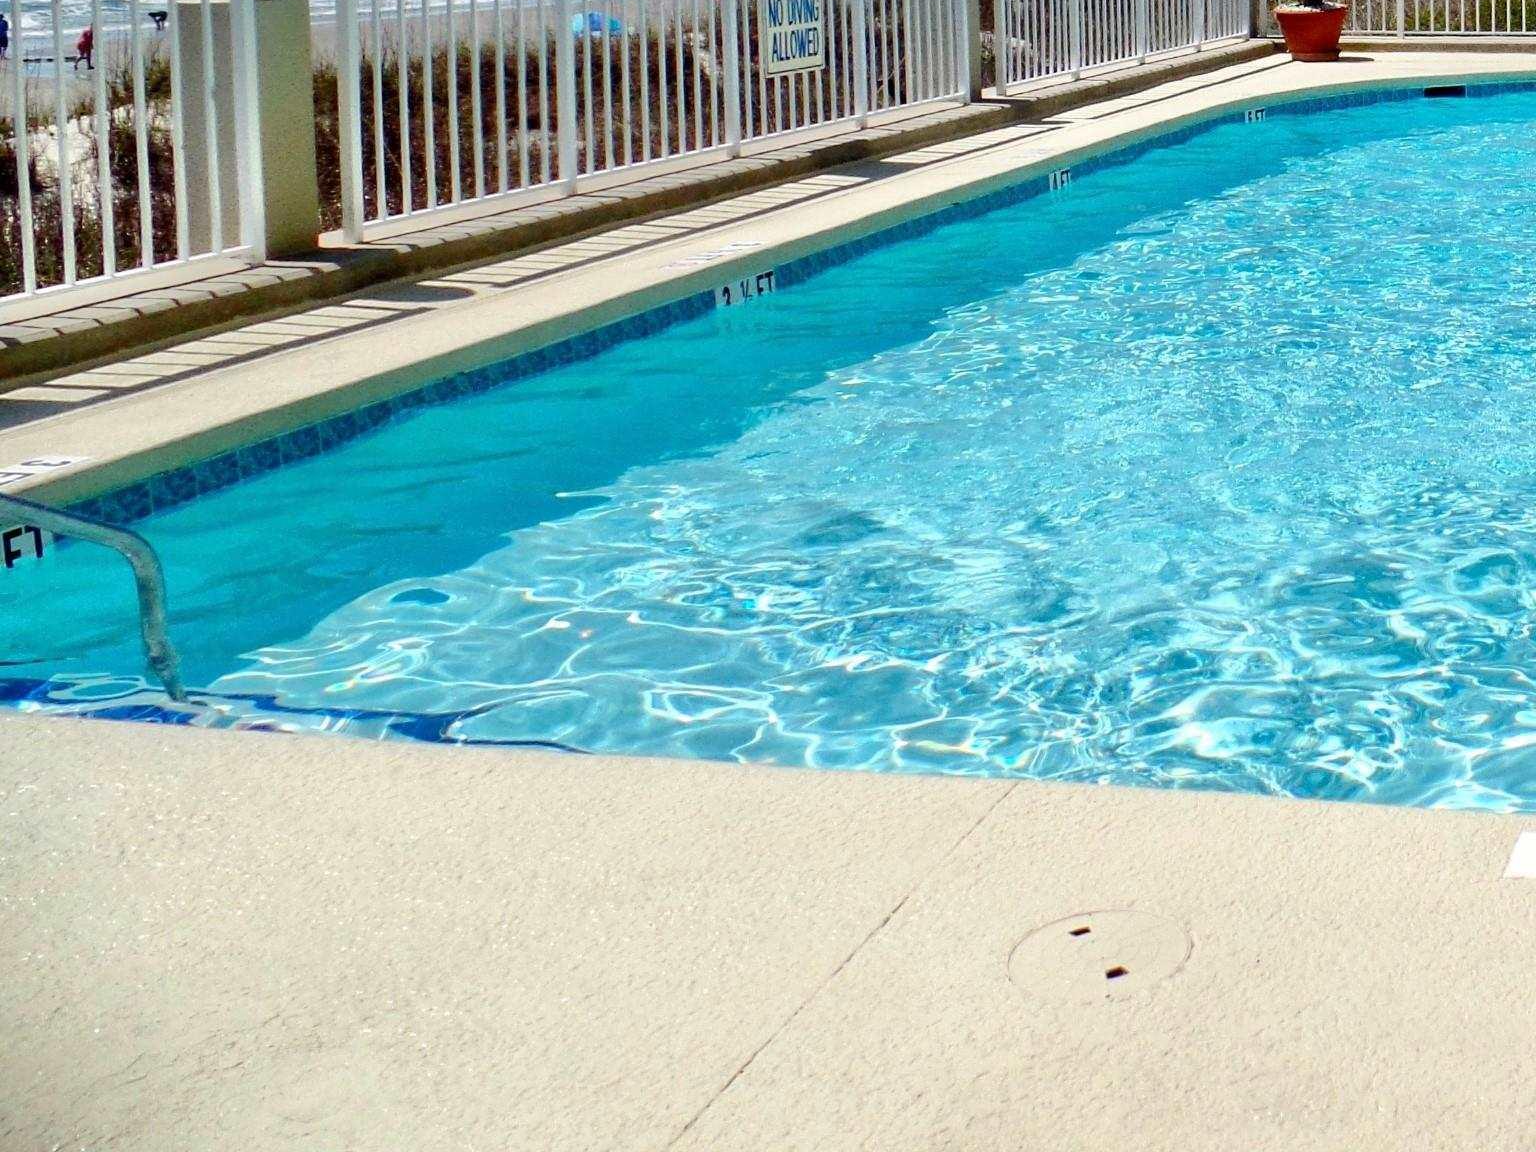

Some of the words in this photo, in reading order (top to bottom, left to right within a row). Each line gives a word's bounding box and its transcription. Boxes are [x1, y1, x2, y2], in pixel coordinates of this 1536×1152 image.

[772, 27, 819, 62] ALLOWED
[756, 270, 774, 296] FT
[2, 525, 43, 568] FT
